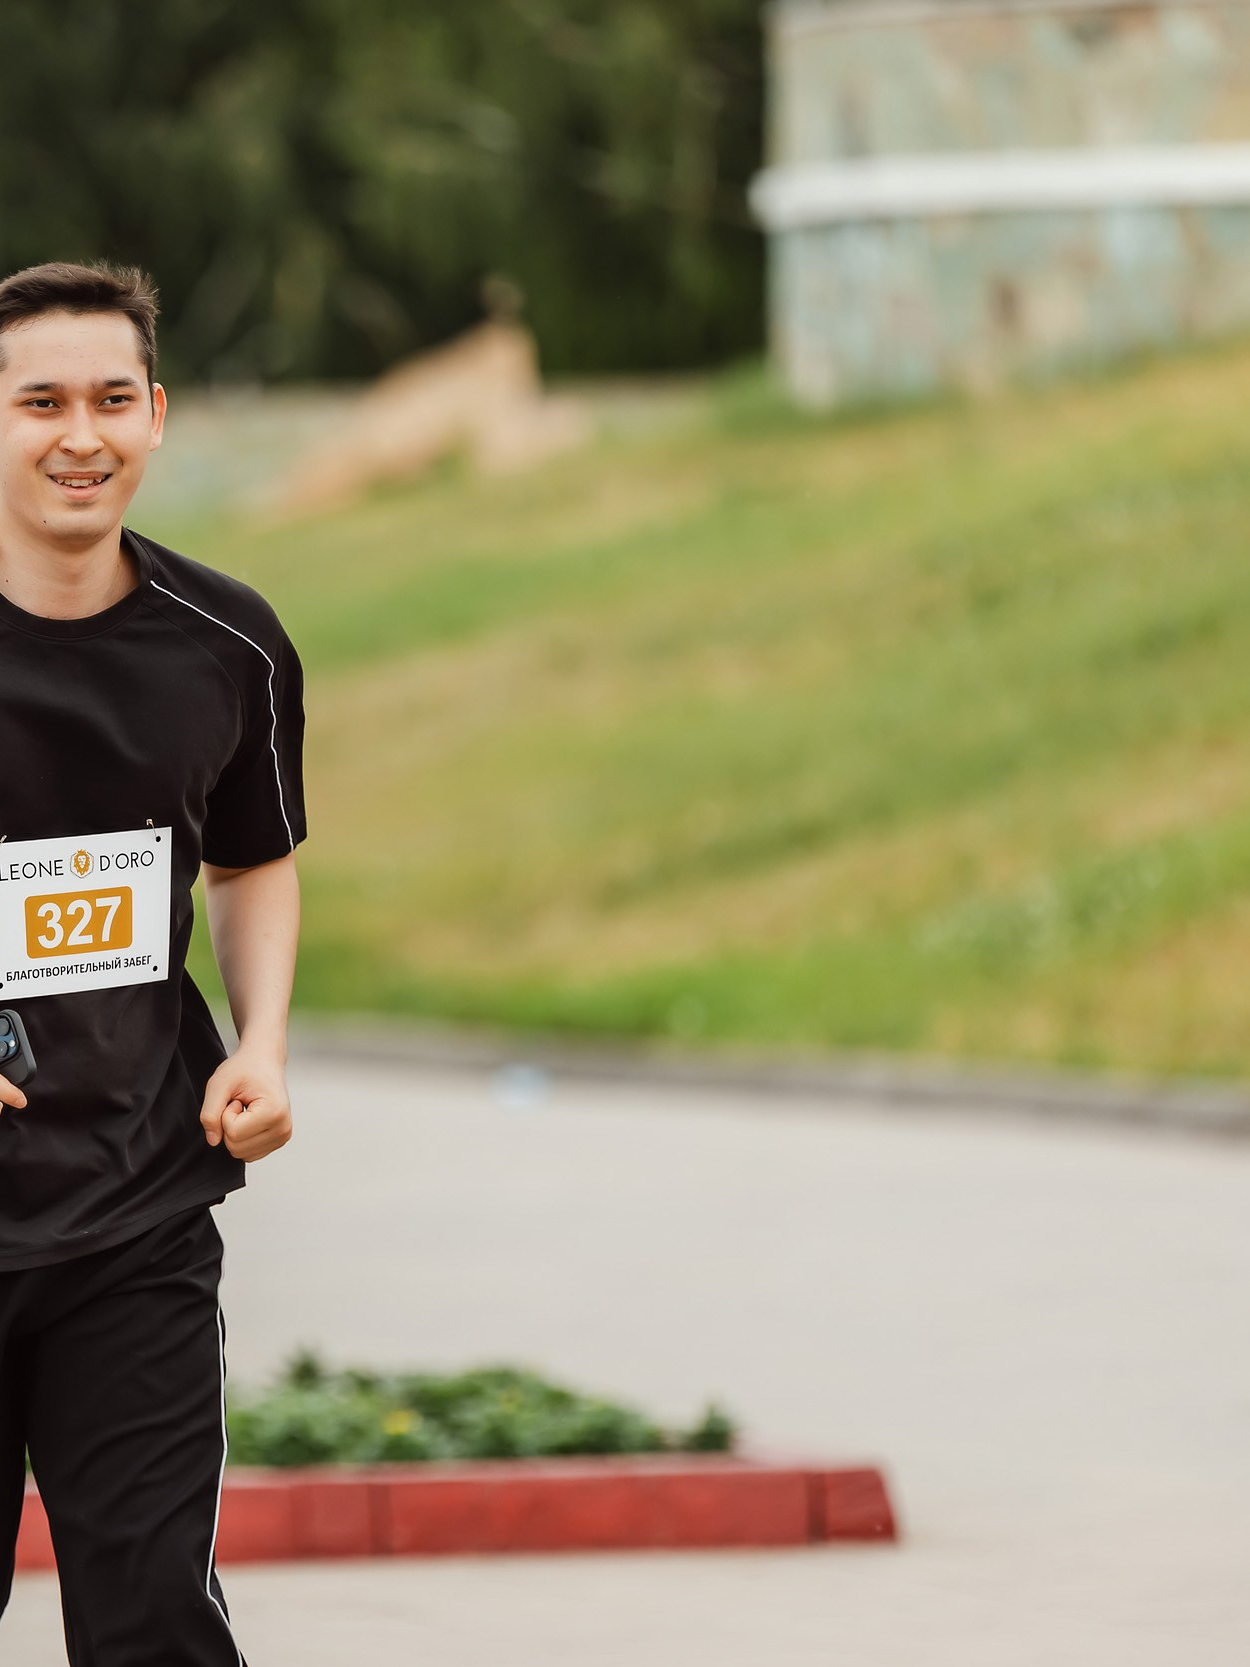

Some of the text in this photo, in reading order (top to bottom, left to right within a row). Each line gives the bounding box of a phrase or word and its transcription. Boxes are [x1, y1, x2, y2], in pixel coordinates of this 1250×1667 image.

[100, 850, 154, 871] D'ORO
[37, 896, 121, 949] 327
[6, 955, 152, 981] БЛАГОТВОРИТЕЛЬНЫЙ ЗАБЕГ
